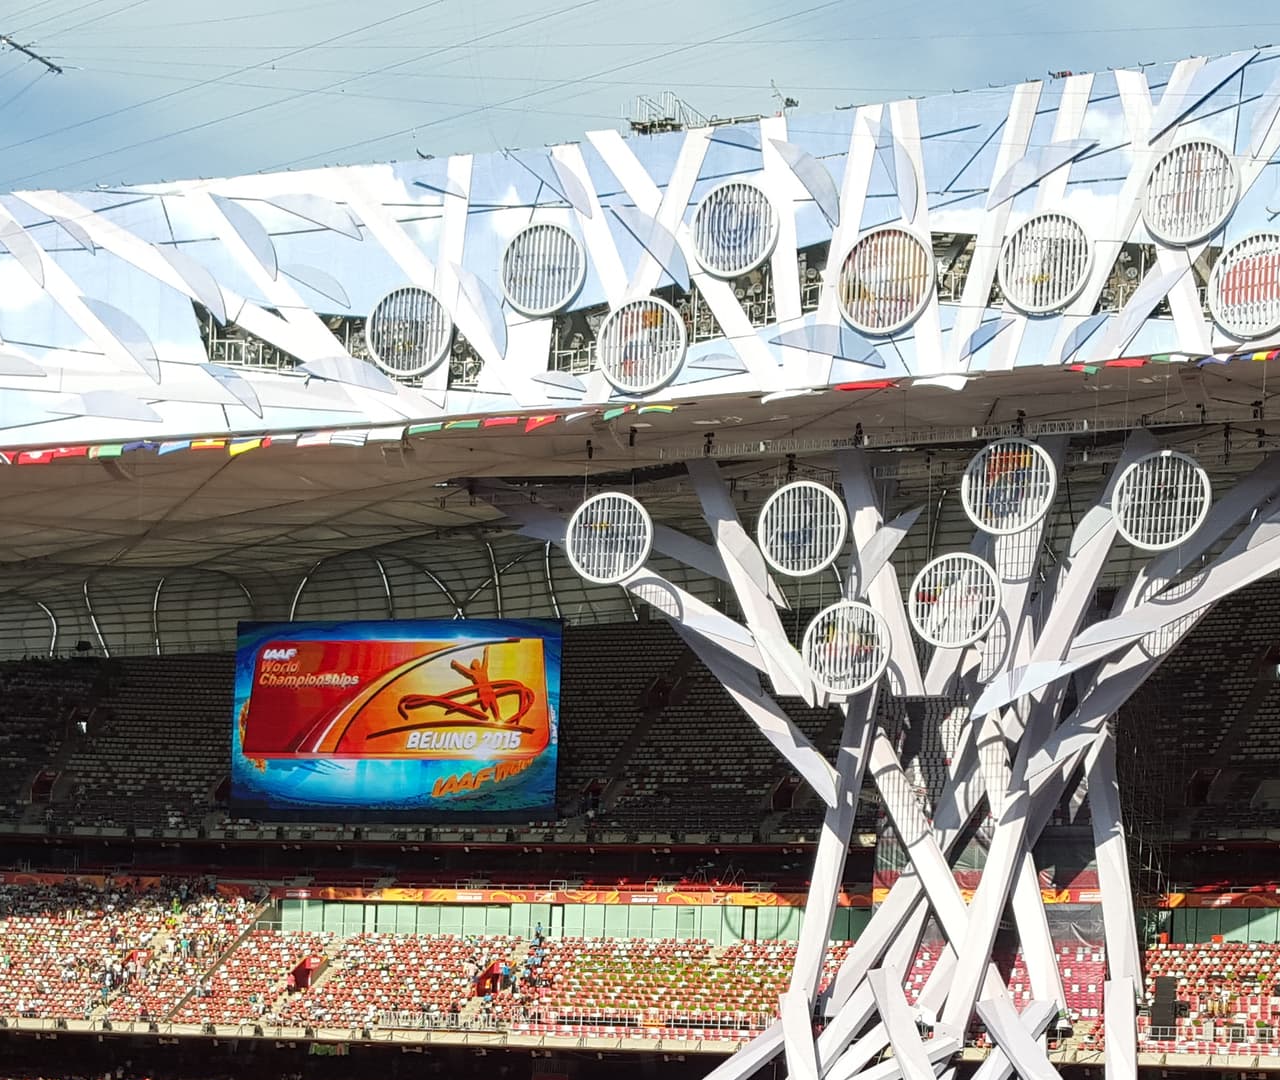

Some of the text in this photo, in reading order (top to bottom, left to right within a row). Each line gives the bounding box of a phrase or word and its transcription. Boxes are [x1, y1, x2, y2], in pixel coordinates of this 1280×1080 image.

[263, 648, 297, 661] IAAF
[261, 661, 300, 674] World
[260, 673, 359, 688] Championships
[406, 731, 522, 749] BEIJING 2015
[432, 767, 494, 797] IAAF
